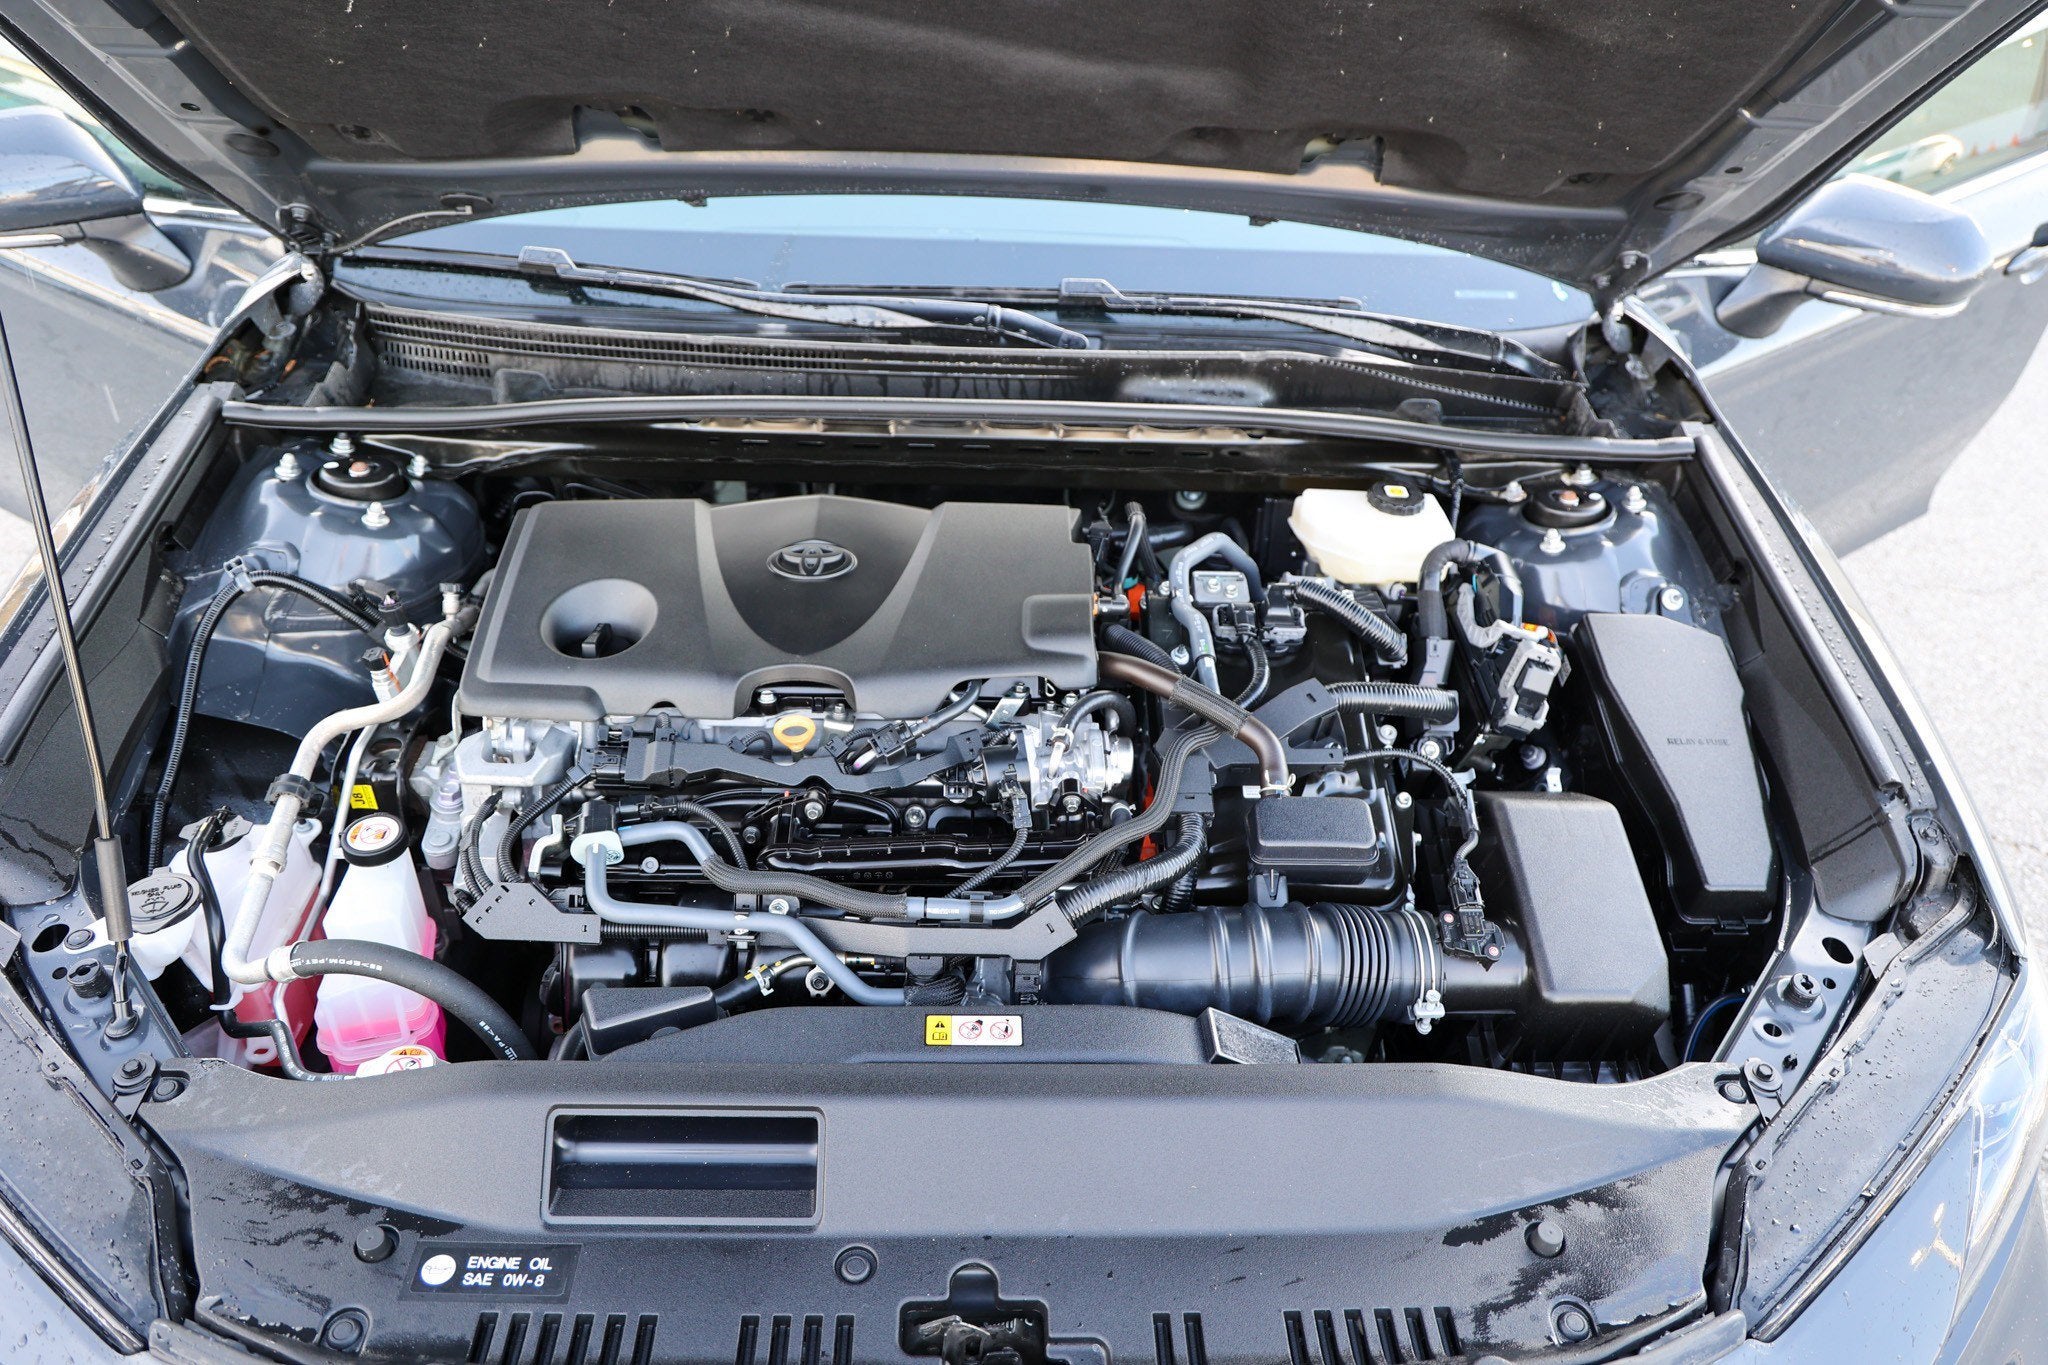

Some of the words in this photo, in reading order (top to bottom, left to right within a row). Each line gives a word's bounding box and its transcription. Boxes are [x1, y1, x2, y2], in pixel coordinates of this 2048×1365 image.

[1666, 738, 1696, 746] RELAY
[466, 1256, 522, 1270] ENGINE
[529, 1257, 553, 1271] OIL
[462, 1272, 495, 1286] SAE
[502, 1273, 546, 1287] 0W-8
